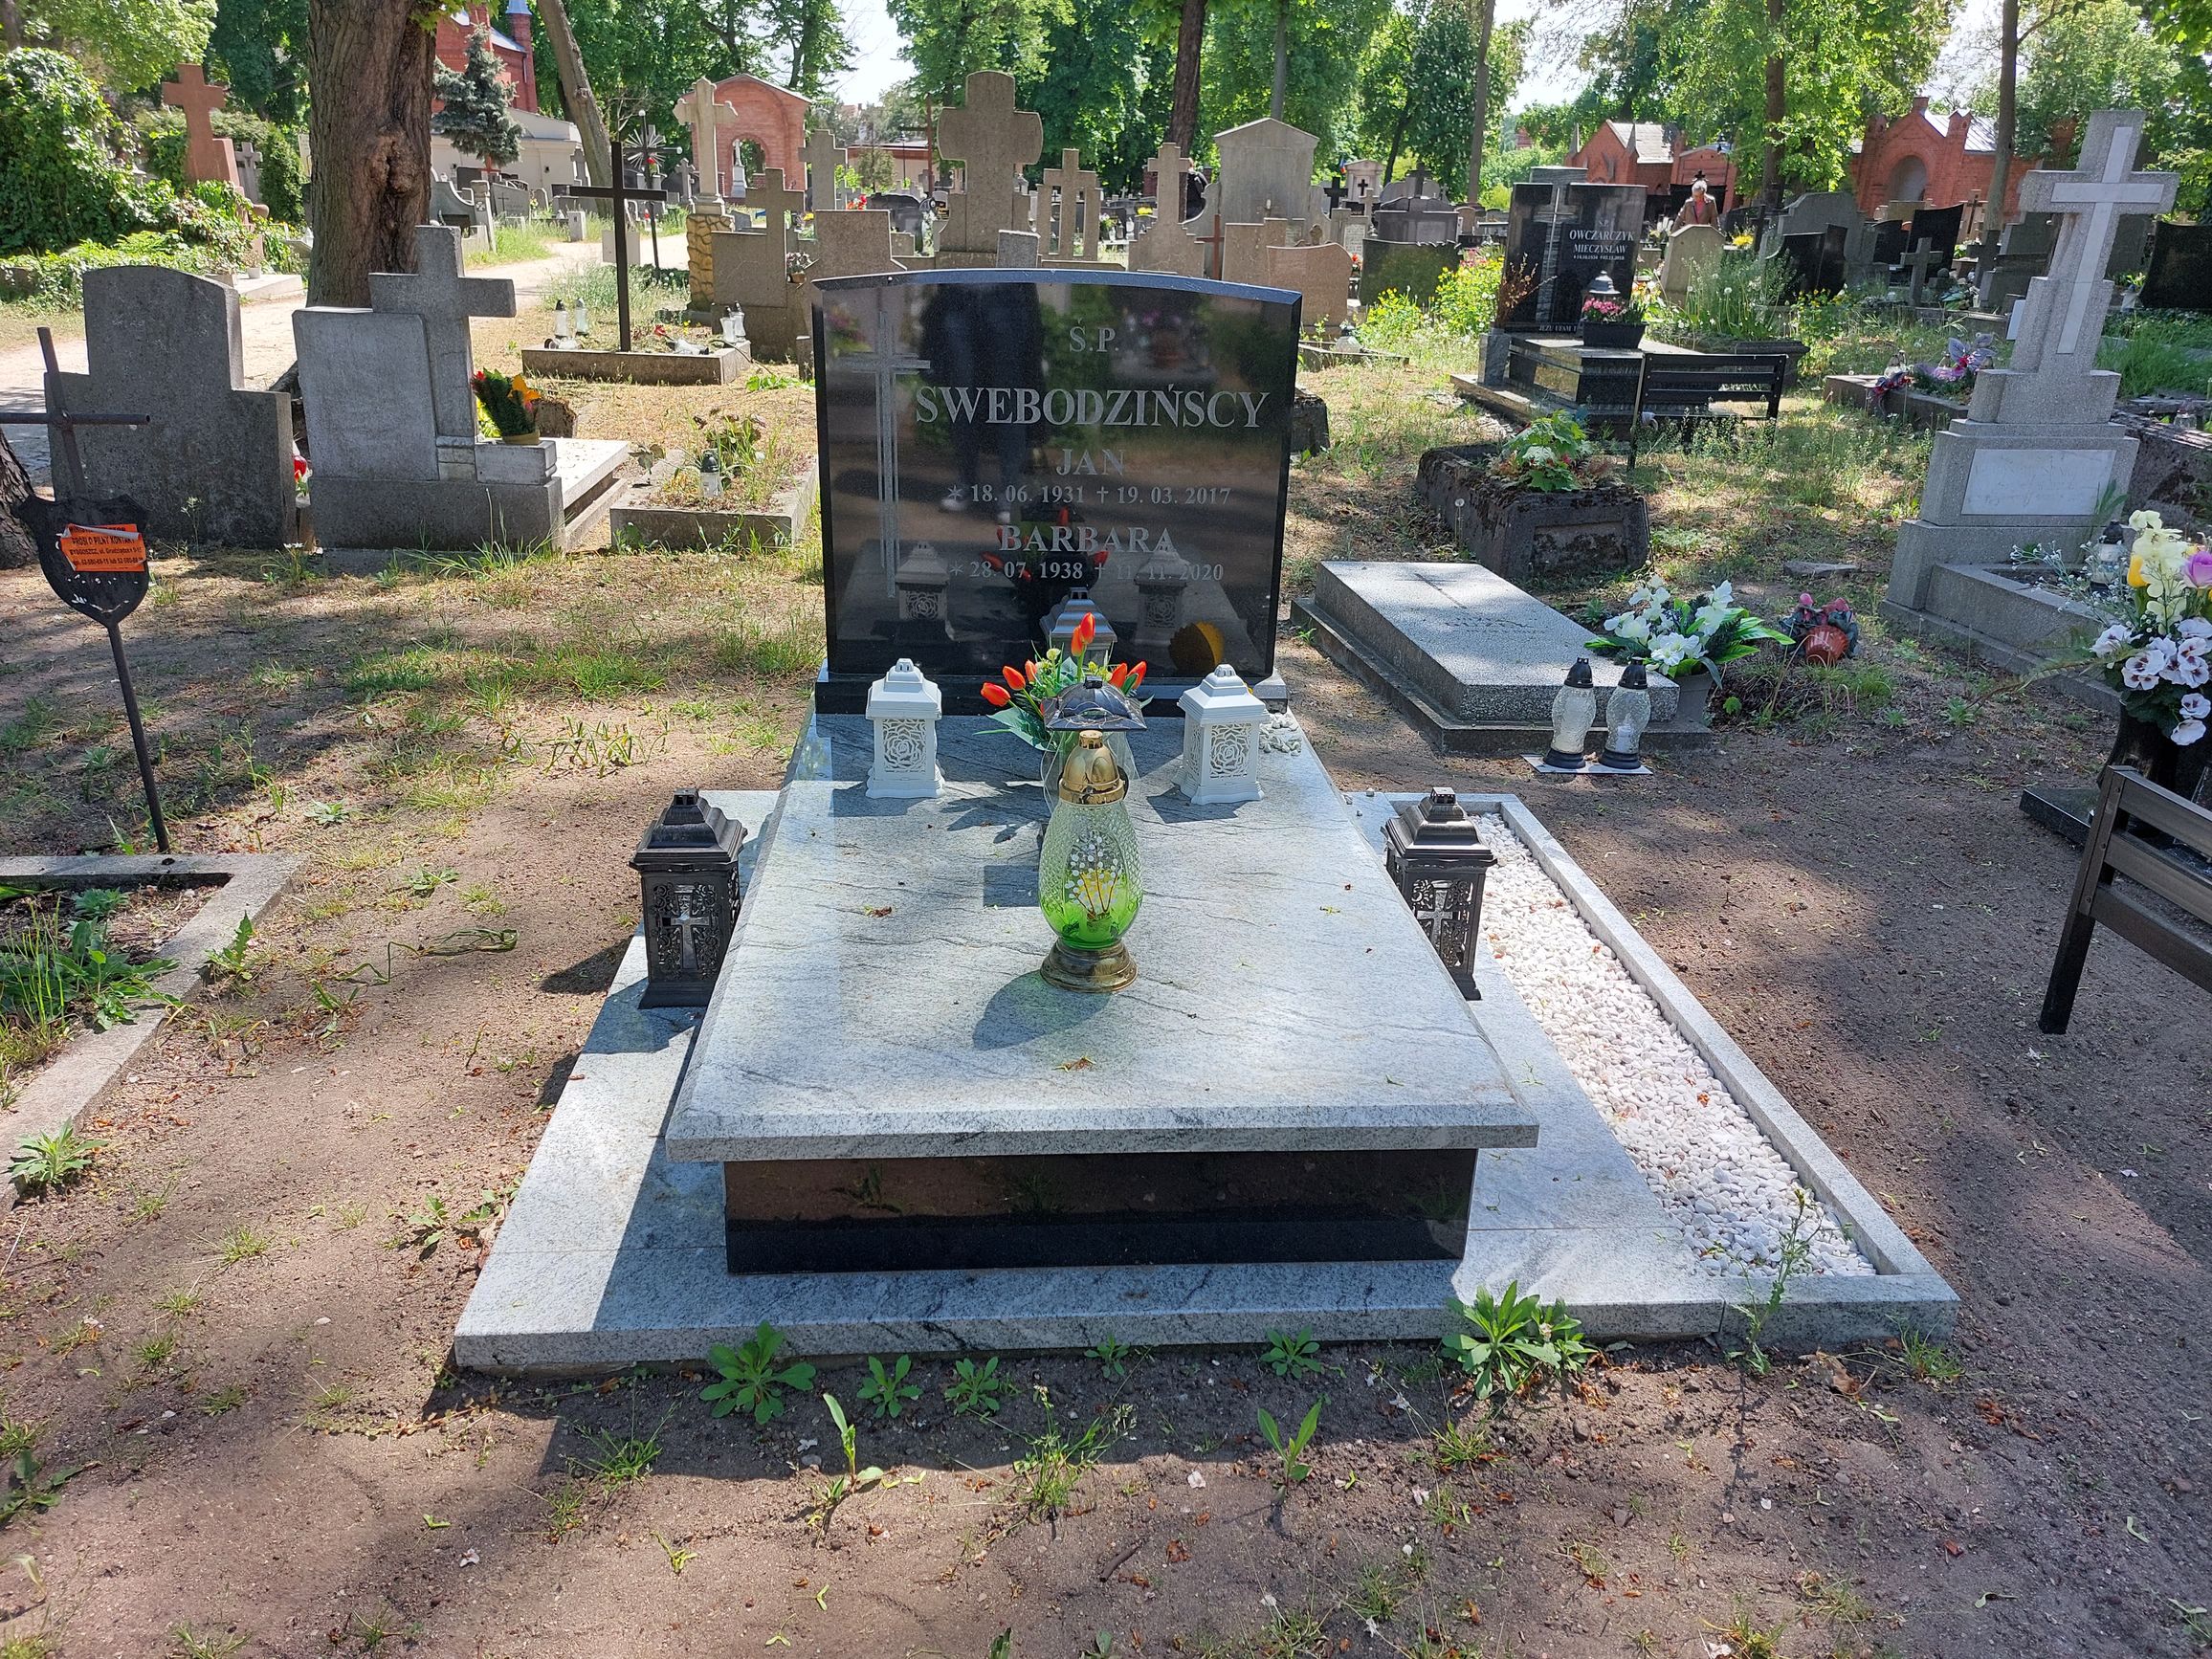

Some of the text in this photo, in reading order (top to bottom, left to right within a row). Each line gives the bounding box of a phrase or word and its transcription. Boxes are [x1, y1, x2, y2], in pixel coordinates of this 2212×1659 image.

[1569, 229, 1634, 241] OWCZARCZYK
[916, 383, 1271, 428] SWEBODZIŃSCY
[1055, 448, 1125, 476] JAN
[971, 483, 1231, 505] 18. 06. 1931 19. 03. 2017
[999, 525, 1176, 553] BARBARA
[1040, 562, 1083, 580] 1938
[1180, 564, 1224, 581] 2020
